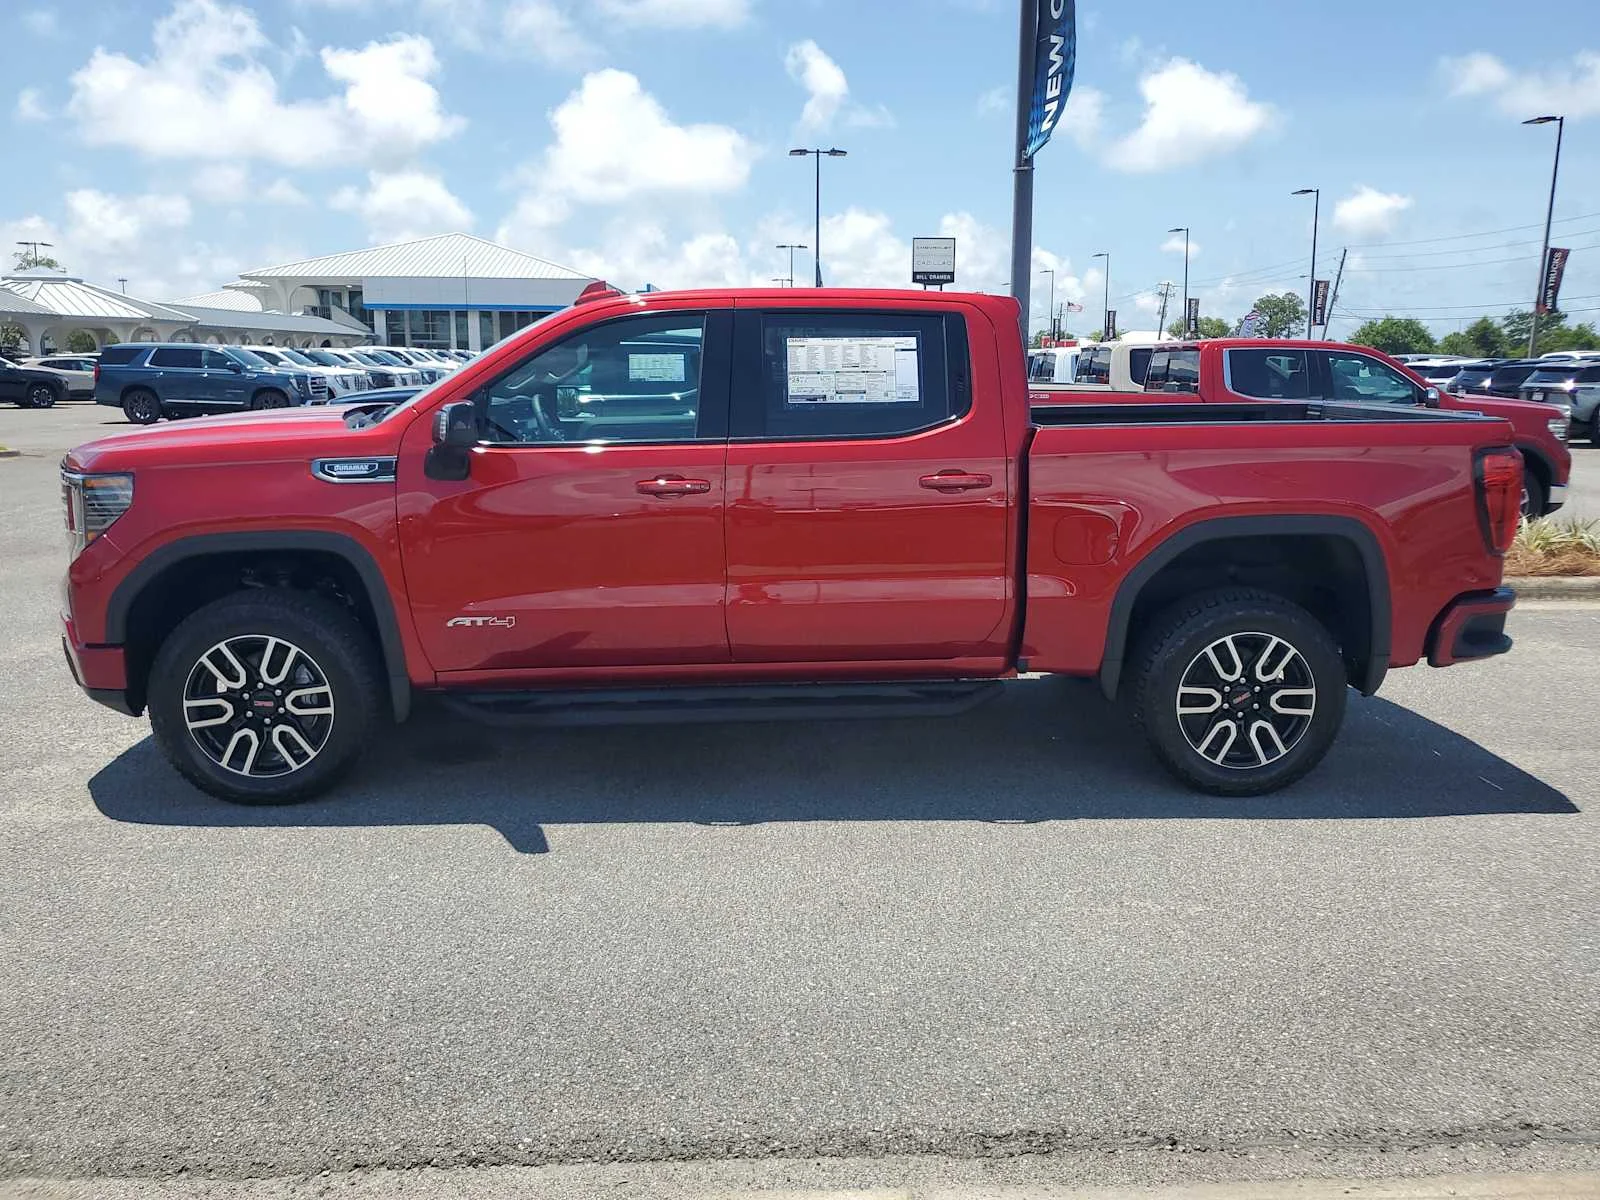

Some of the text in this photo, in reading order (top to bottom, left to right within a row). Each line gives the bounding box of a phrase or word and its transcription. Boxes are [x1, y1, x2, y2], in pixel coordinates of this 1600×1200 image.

[1040, 34, 1065, 133] NEW
[1545, 251, 1562, 309] NEW TRUCKS
[334, 464, 369, 472] DURAMAX
[447, 616, 515, 628] AT4
